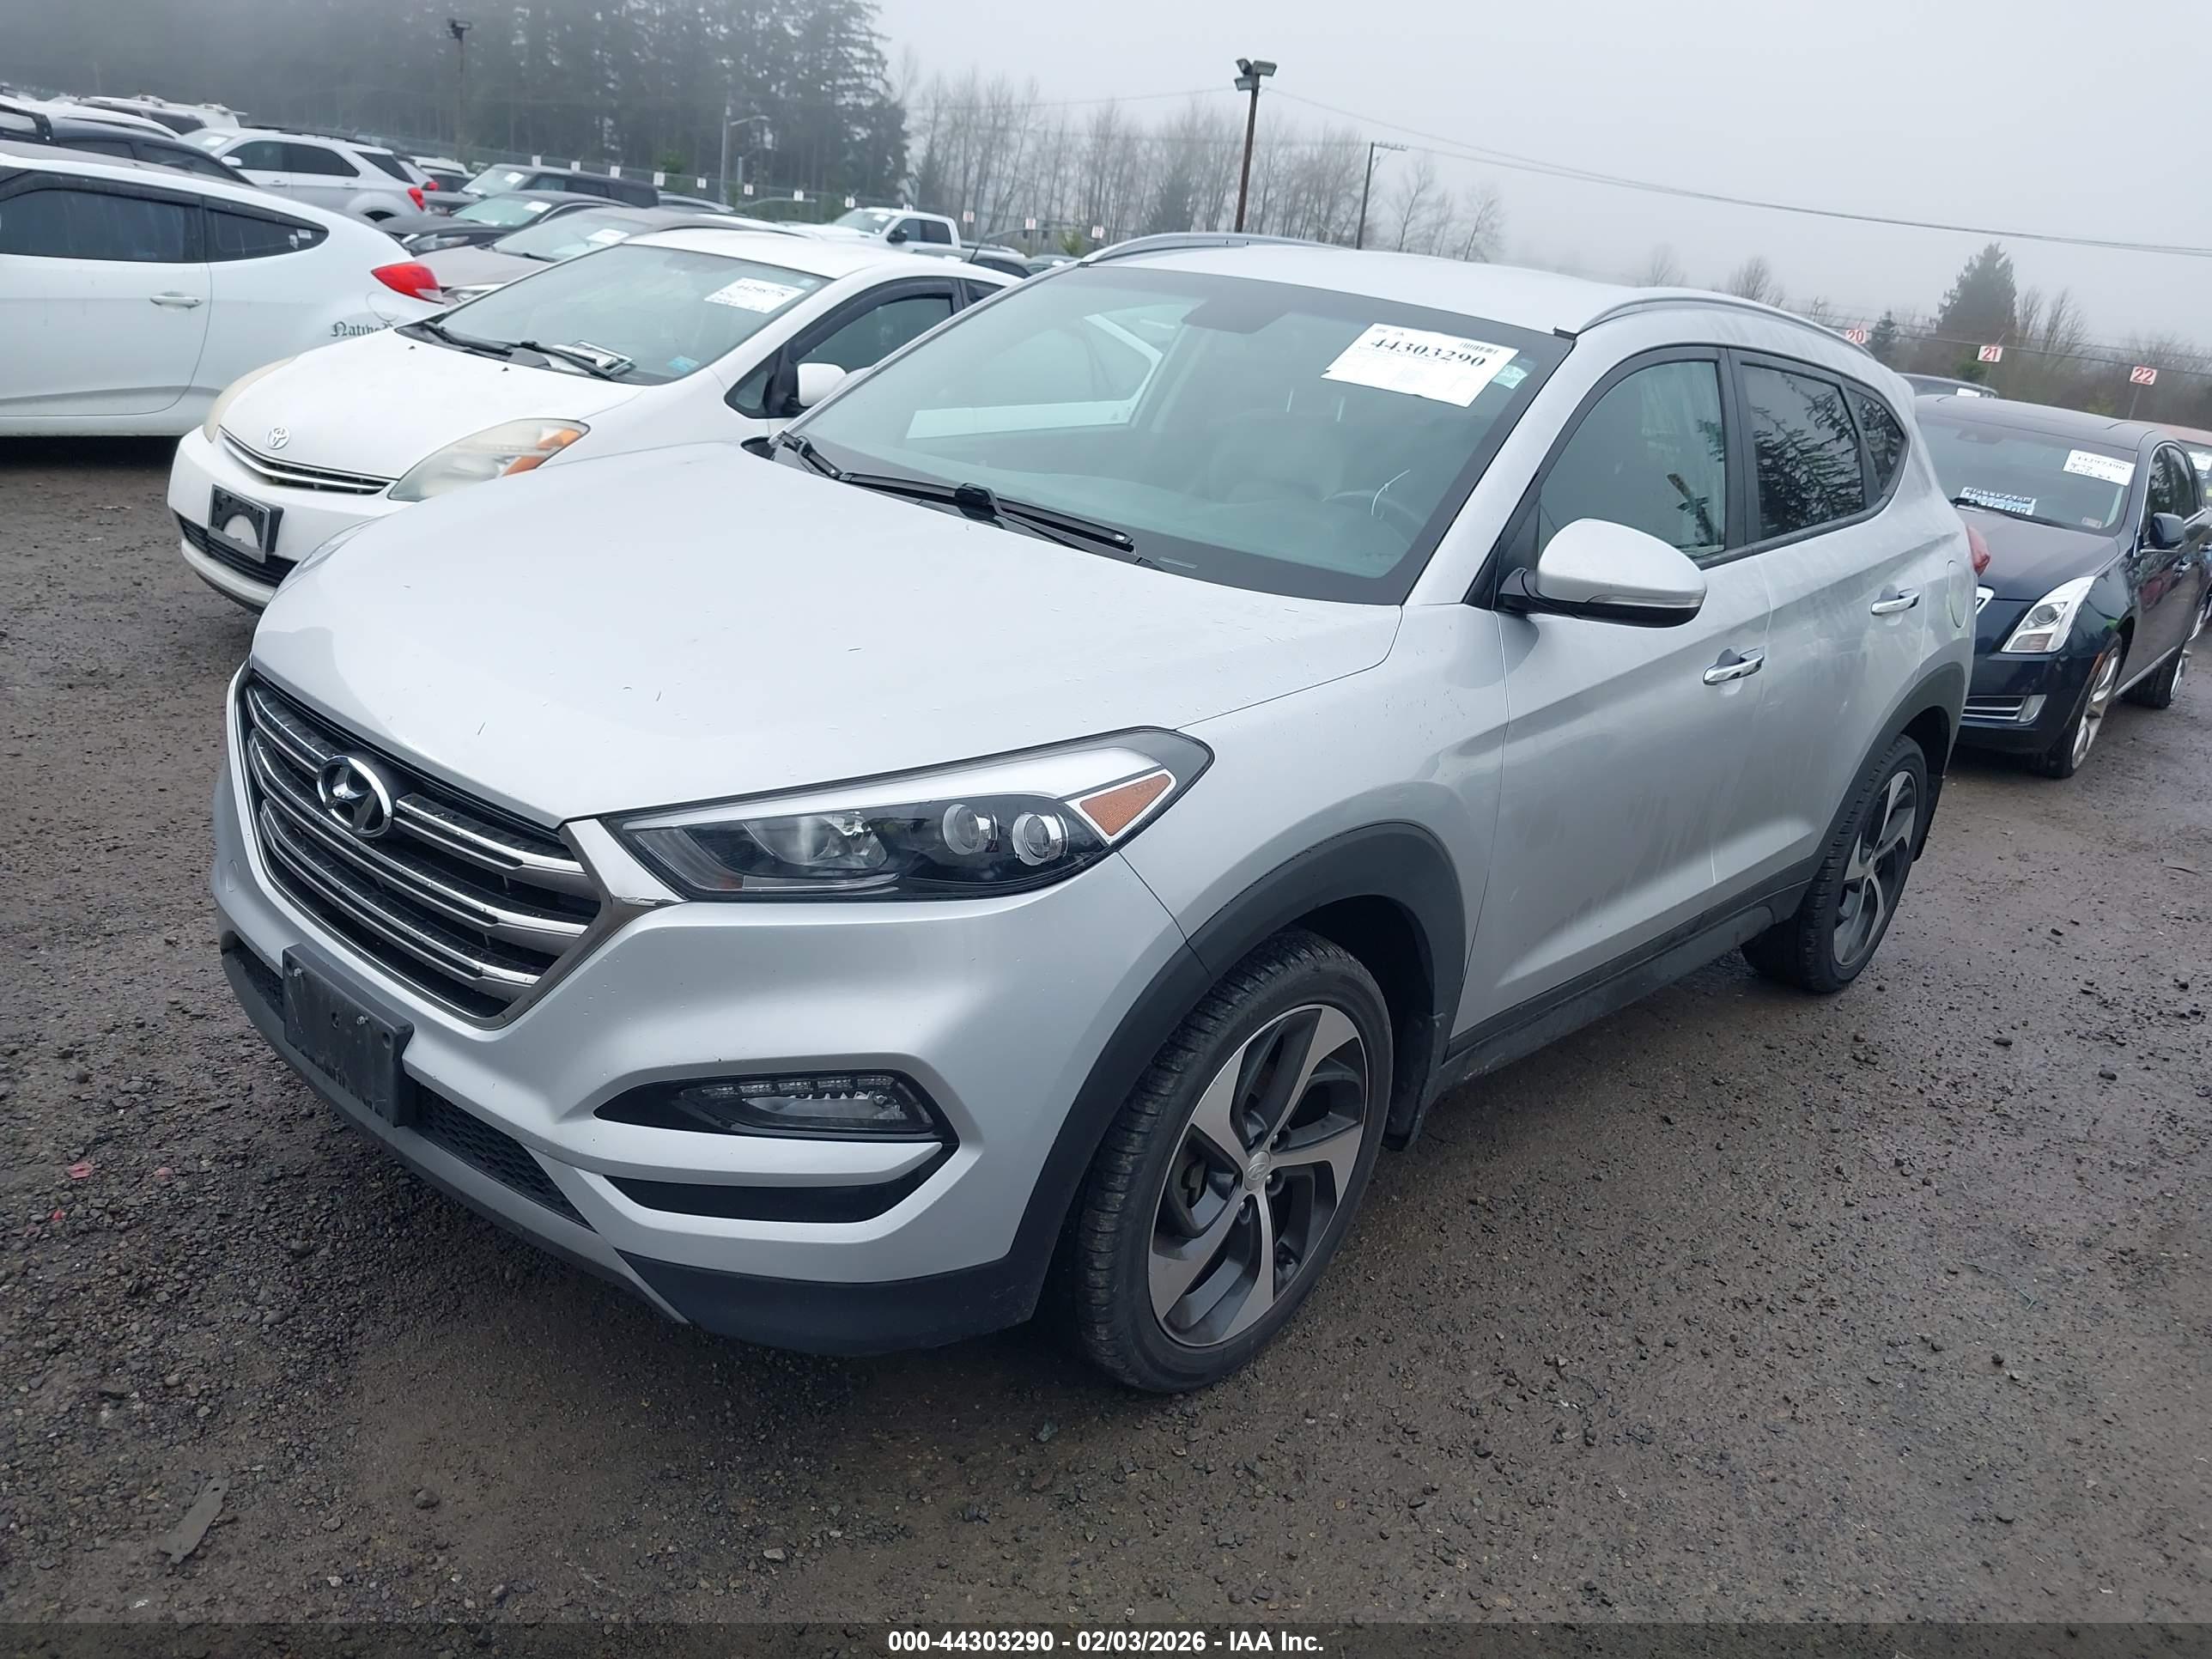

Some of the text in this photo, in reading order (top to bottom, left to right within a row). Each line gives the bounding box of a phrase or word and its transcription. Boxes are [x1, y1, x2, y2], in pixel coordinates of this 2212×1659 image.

[1848, 330, 1864, 343] 20
[1370, 337, 1486, 367] 44303290
[1982, 347, 1998, 360] 21
[2133, 368, 2154, 384] 22
